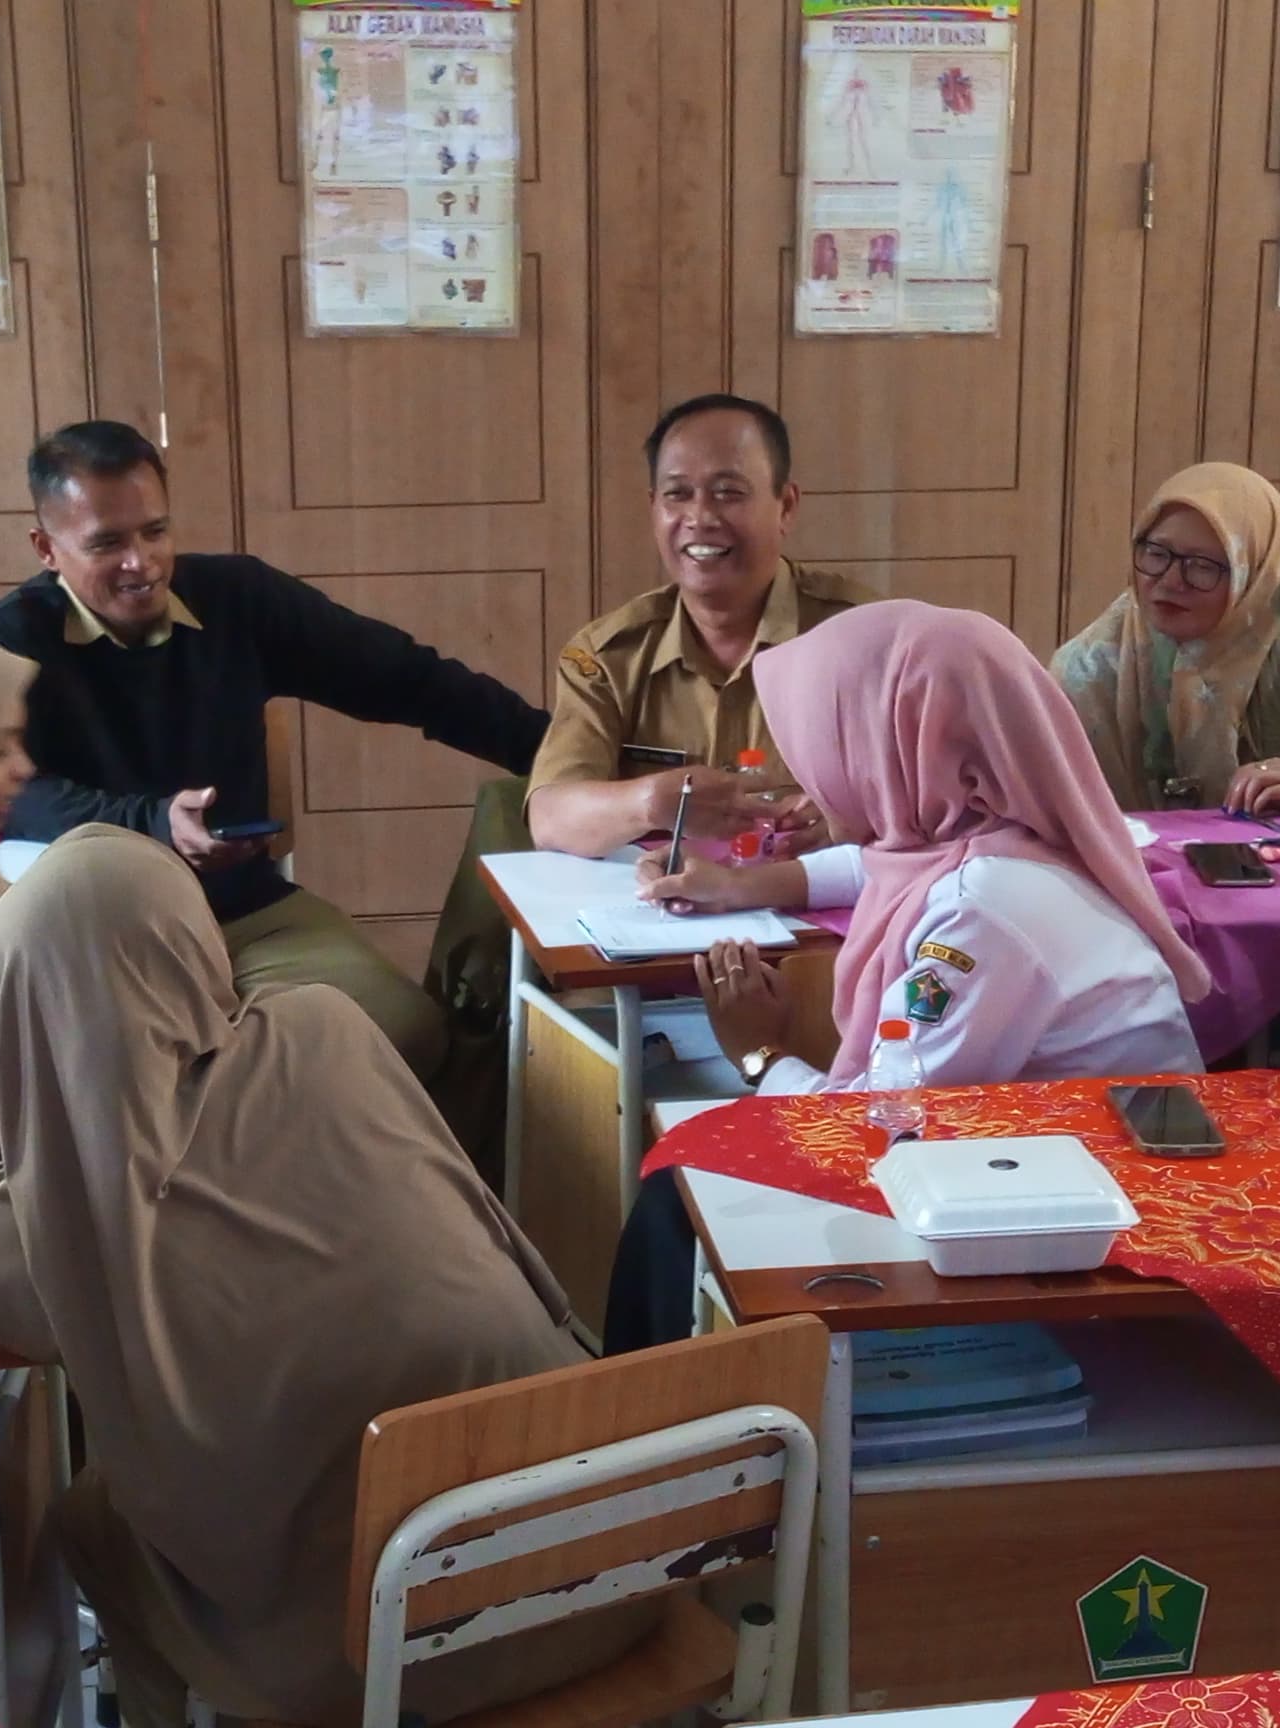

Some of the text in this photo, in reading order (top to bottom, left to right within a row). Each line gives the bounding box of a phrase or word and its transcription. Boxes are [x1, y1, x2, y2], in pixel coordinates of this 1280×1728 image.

[327, 15, 485, 35] ALAT GERAK MANUSIA
[832, 25, 986, 46] PEREDARAN DARAH MANUSIA
